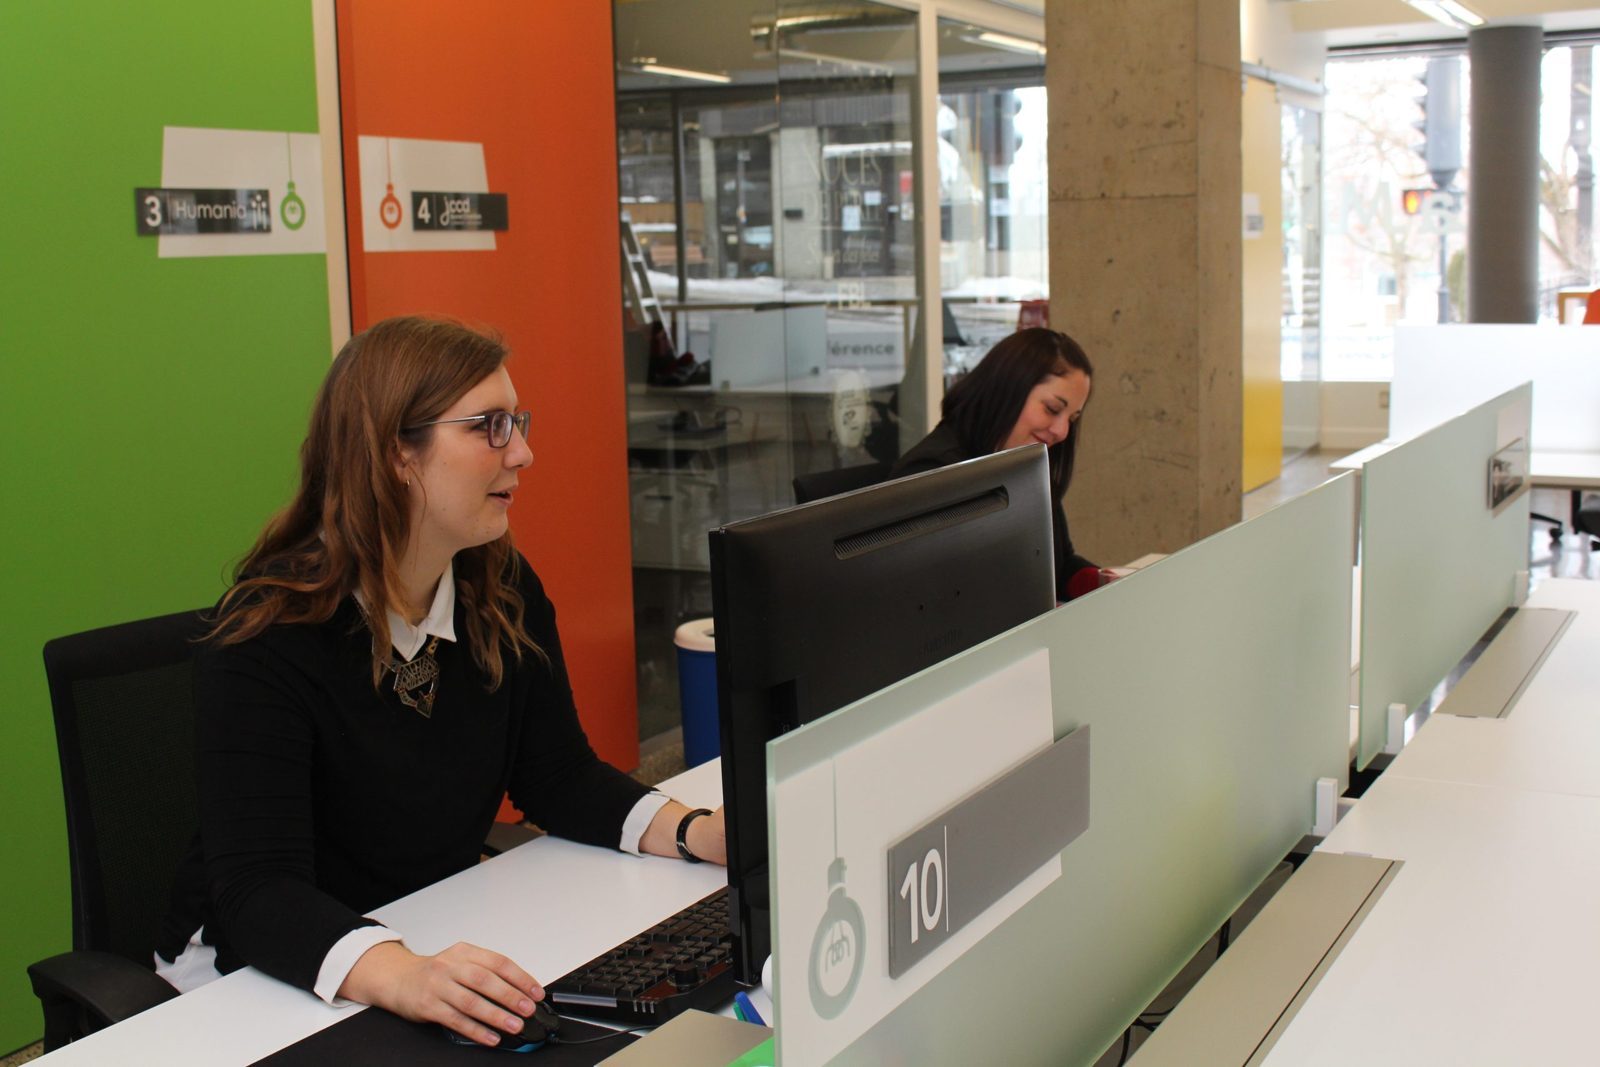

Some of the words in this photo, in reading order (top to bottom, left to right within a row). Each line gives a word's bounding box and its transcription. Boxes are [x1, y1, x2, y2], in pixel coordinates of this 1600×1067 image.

[144, 195, 162, 227] 3
[174, 200, 247, 219] Humania
[418, 197, 431, 224] 4
[900, 848, 943, 944] 10
